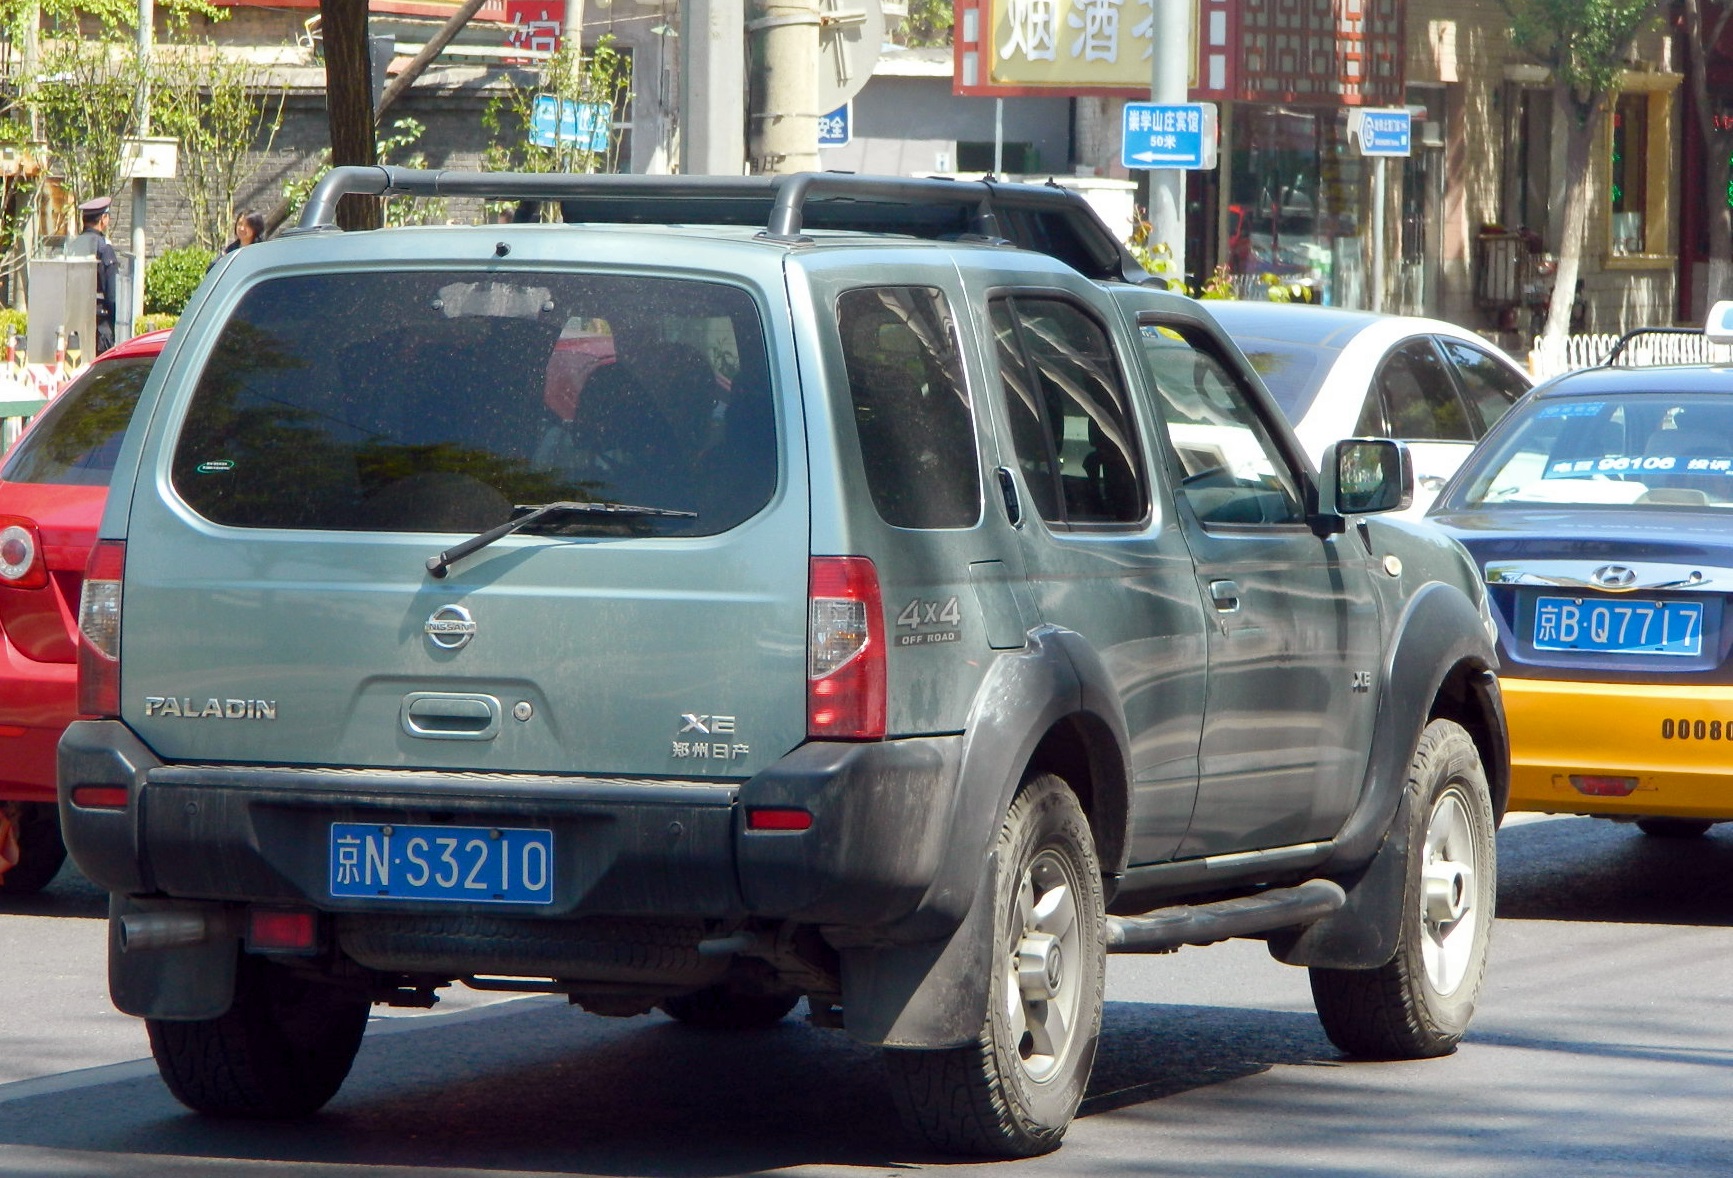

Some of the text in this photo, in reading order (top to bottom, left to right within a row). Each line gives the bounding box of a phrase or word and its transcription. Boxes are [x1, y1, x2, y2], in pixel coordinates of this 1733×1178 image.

[1150, 135, 1177, 149] 50米
[429, 623, 469, 631] NISSAN
[902, 632, 955, 645] OFF ROAD
[1351, 671, 1371, 687] XE
[145, 696, 276, 719] PALADIN
[680, 713, 735, 735] XE
[672, 741, 749, 760] 郑州日产
